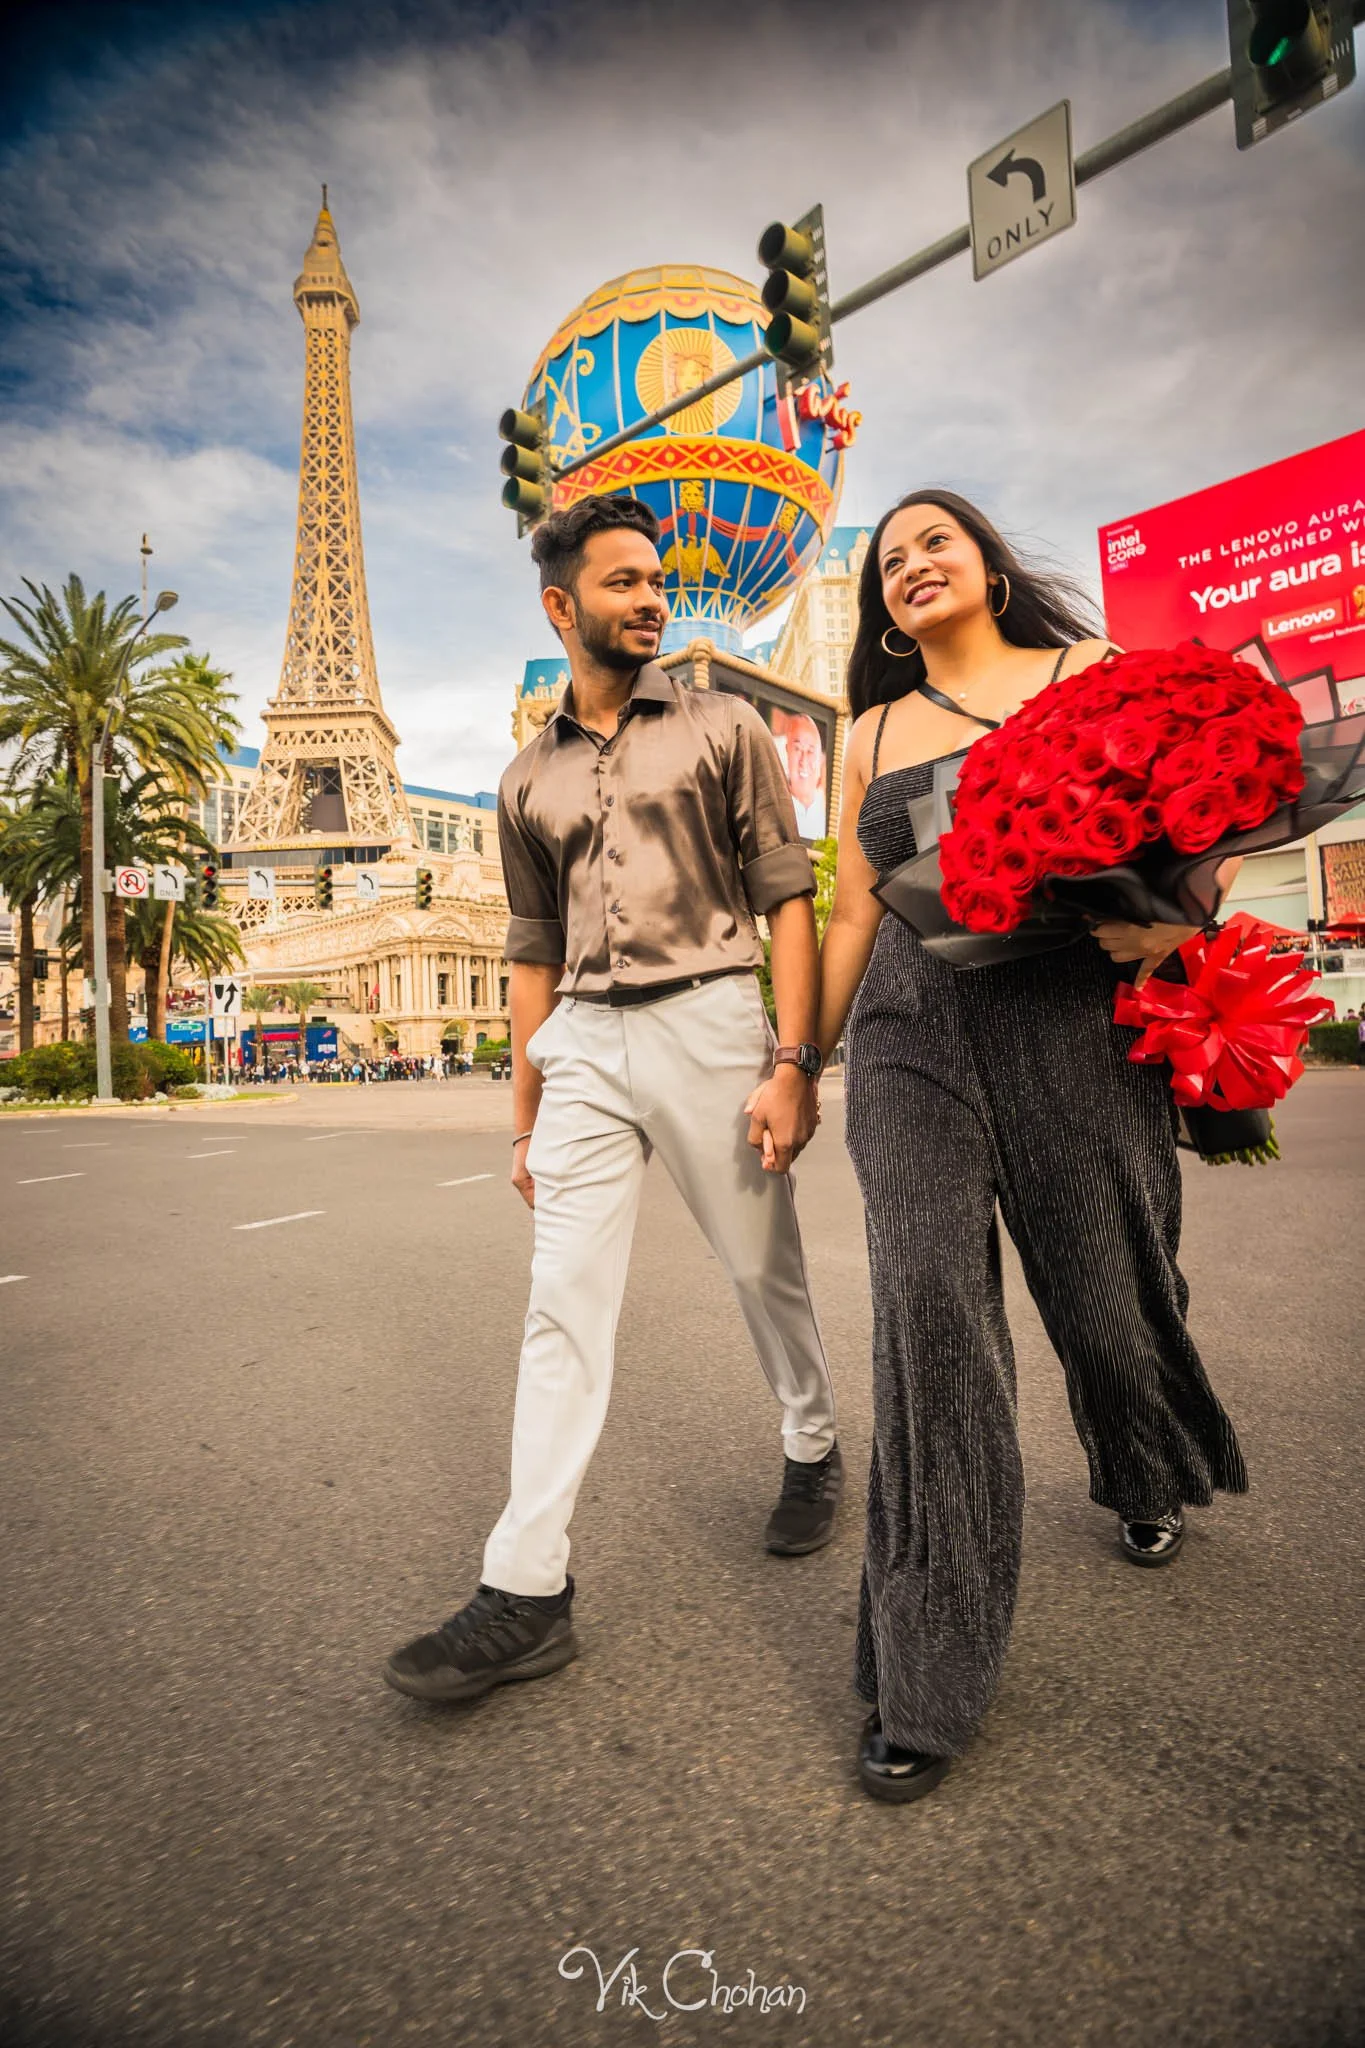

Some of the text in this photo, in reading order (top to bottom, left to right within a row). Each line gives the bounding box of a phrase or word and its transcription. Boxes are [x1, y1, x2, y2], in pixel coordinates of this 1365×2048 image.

[987, 201, 1054, 260] ONLY
[1107, 529, 1140, 554] intel
[1178, 499, 1365, 569] THE LENOVO AURA
[1234, 528, 1332, 568] IMAGINED
[1190, 576, 1262, 613] Your
[1269, 553, 1342, 591] aura
[1268, 608, 1335, 637] Lenovo
